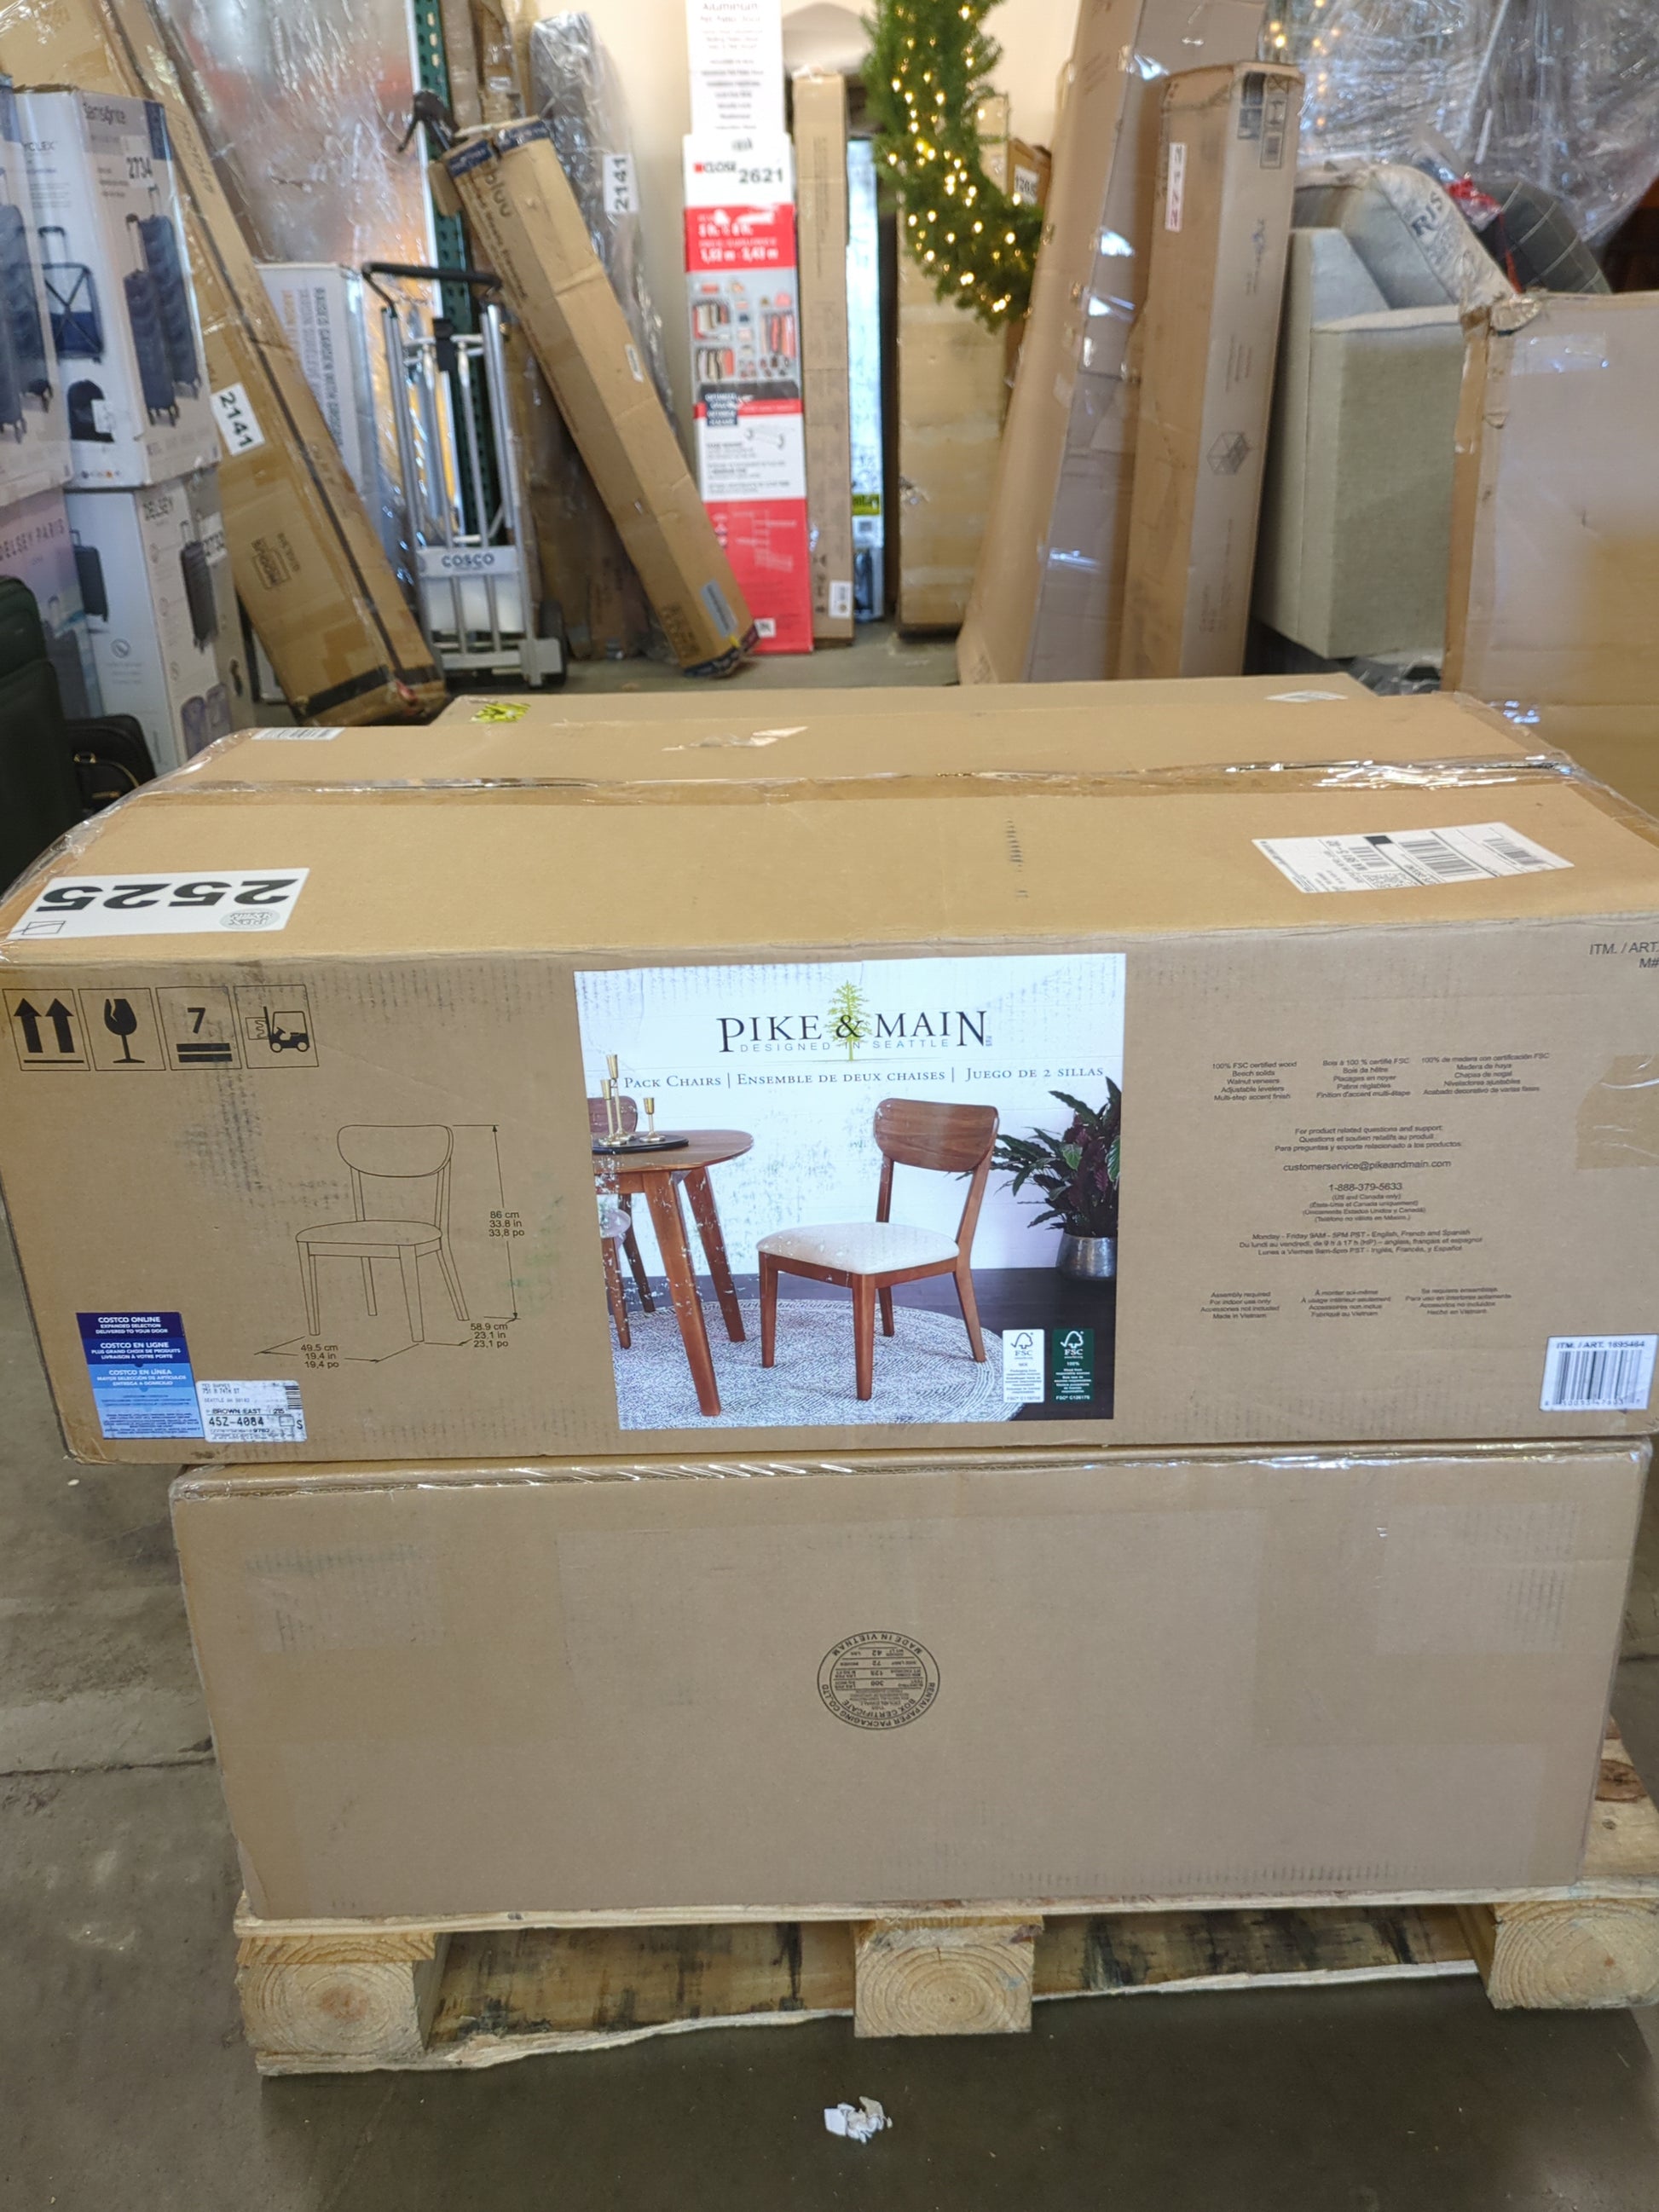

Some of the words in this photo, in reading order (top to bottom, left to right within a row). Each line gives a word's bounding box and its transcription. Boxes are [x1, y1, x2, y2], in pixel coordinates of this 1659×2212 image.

[739, 168, 783, 183] 2621
[612, 157, 630, 211] 2141
[219, 391, 254, 448] 2141
[36, 878, 299, 913] 2525
[1589, 943, 1617, 955] ITM.
[187, 1007, 205, 1034] 7
[716, 1014, 823, 1053] PIKE
[835, 1014, 864, 1039] &
[875, 1011, 987, 1048] MAIN
[740, 1042, 830, 1053] DESIGNED
[873, 1038, 948, 1049] SEATTLE
[625, 1077, 661, 1089] PACK
[666, 1075, 721, 1088] CHAIRS
[737, 1073, 812, 1085] ENSEMBLE
[843, 1072, 881, 1083] DEUX
[887, 1071, 945, 1082] CHAISES
[965, 1067, 1012, 1082] JUEGO
[1043, 1069, 1051, 1077] 2
[1057, 1067, 1103, 1077] SILLAS
[1293, 1144, 1329, 1152] preguntas
[1282, 1160, 1452, 1172] customerservice@pikeandmain.com
[1329, 1182, 1402, 1192] 1-888-379-5633
[490, 1210, 502, 1219] 86
[489, 1219, 511, 1227] 33.8
[513, 1219, 522, 1227] in
[488, 1228, 511, 1238] 33,8
[512, 1229, 525, 1239] po
[300, 1343, 321, 1352] 49.5
[473, 1340, 494, 1349] 23,1
[496, 1340, 508, 1349] po
[304, 1360, 326, 1369] 19,4
[209, 1417, 264, 1426] 45Z-4084
[296, 1419, 303, 1429] S
[894, 1636, 923, 1655] MADE
[841, 1699, 898, 1718] CERTIFICATE
[899, 1698, 916, 1713] BOX
[839, 1710, 892, 1728] PACKAGING
[894, 1707, 921, 1725] PAPER
